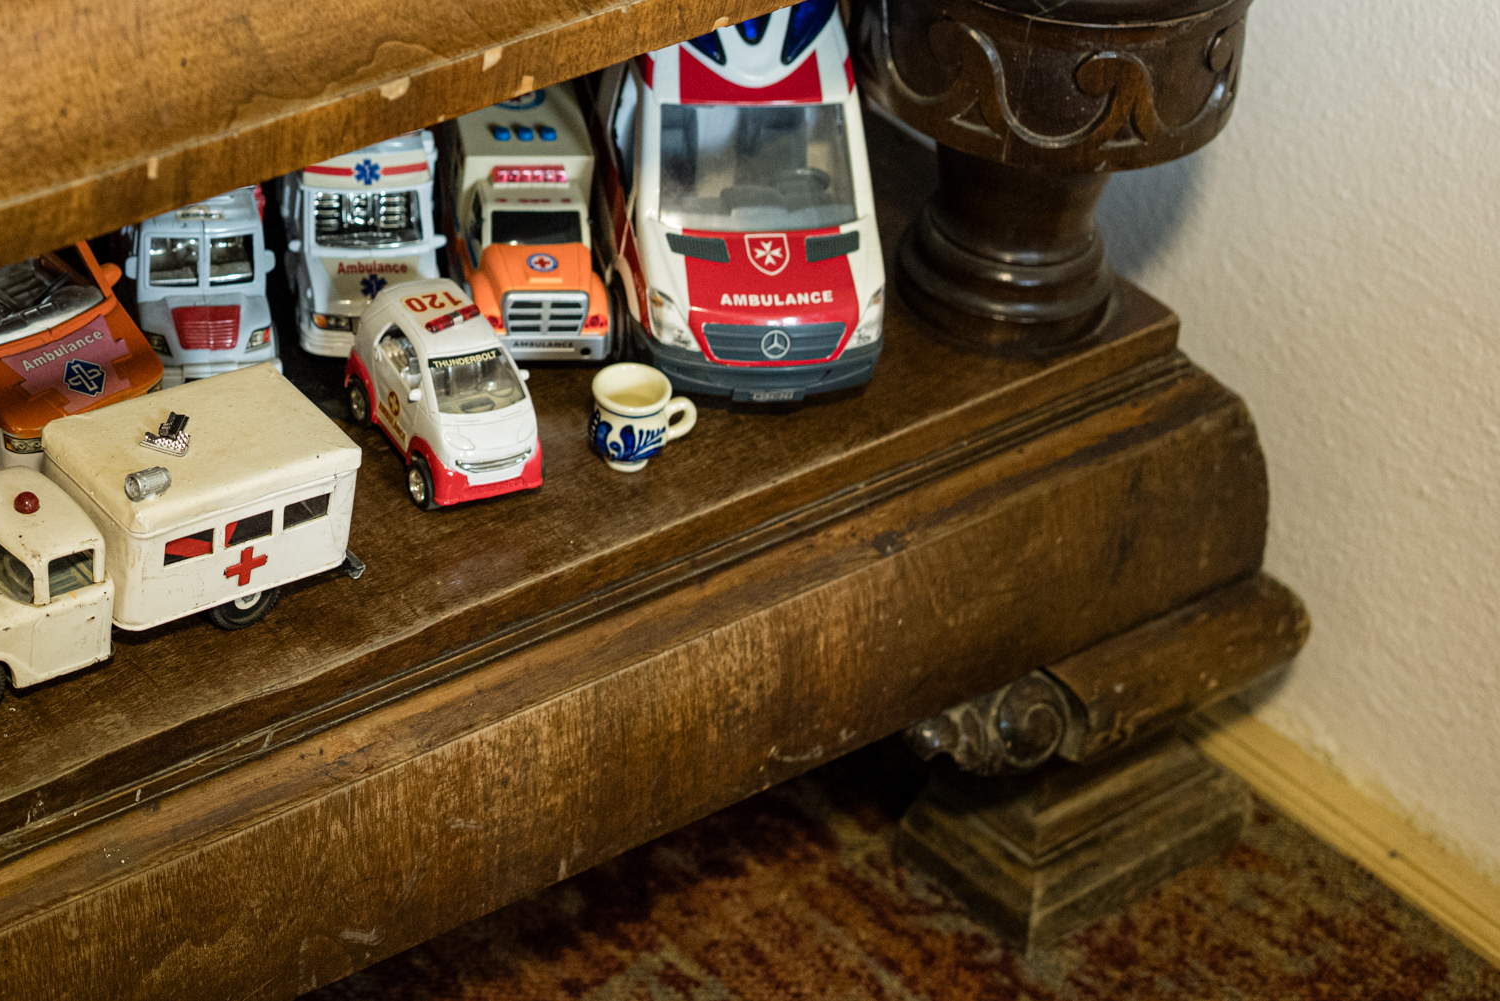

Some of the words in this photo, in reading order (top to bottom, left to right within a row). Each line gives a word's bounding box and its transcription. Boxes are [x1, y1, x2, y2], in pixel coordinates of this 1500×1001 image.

[337, 261, 408, 275] Ambulance
[404, 290, 463, 313] 120
[720, 290, 834, 307] AMBULANCE
[22, 331, 103, 371] Ambulance
[513, 340, 574, 349] AMBULANCE
[432, 350, 498, 369] THUNDERBOLT
